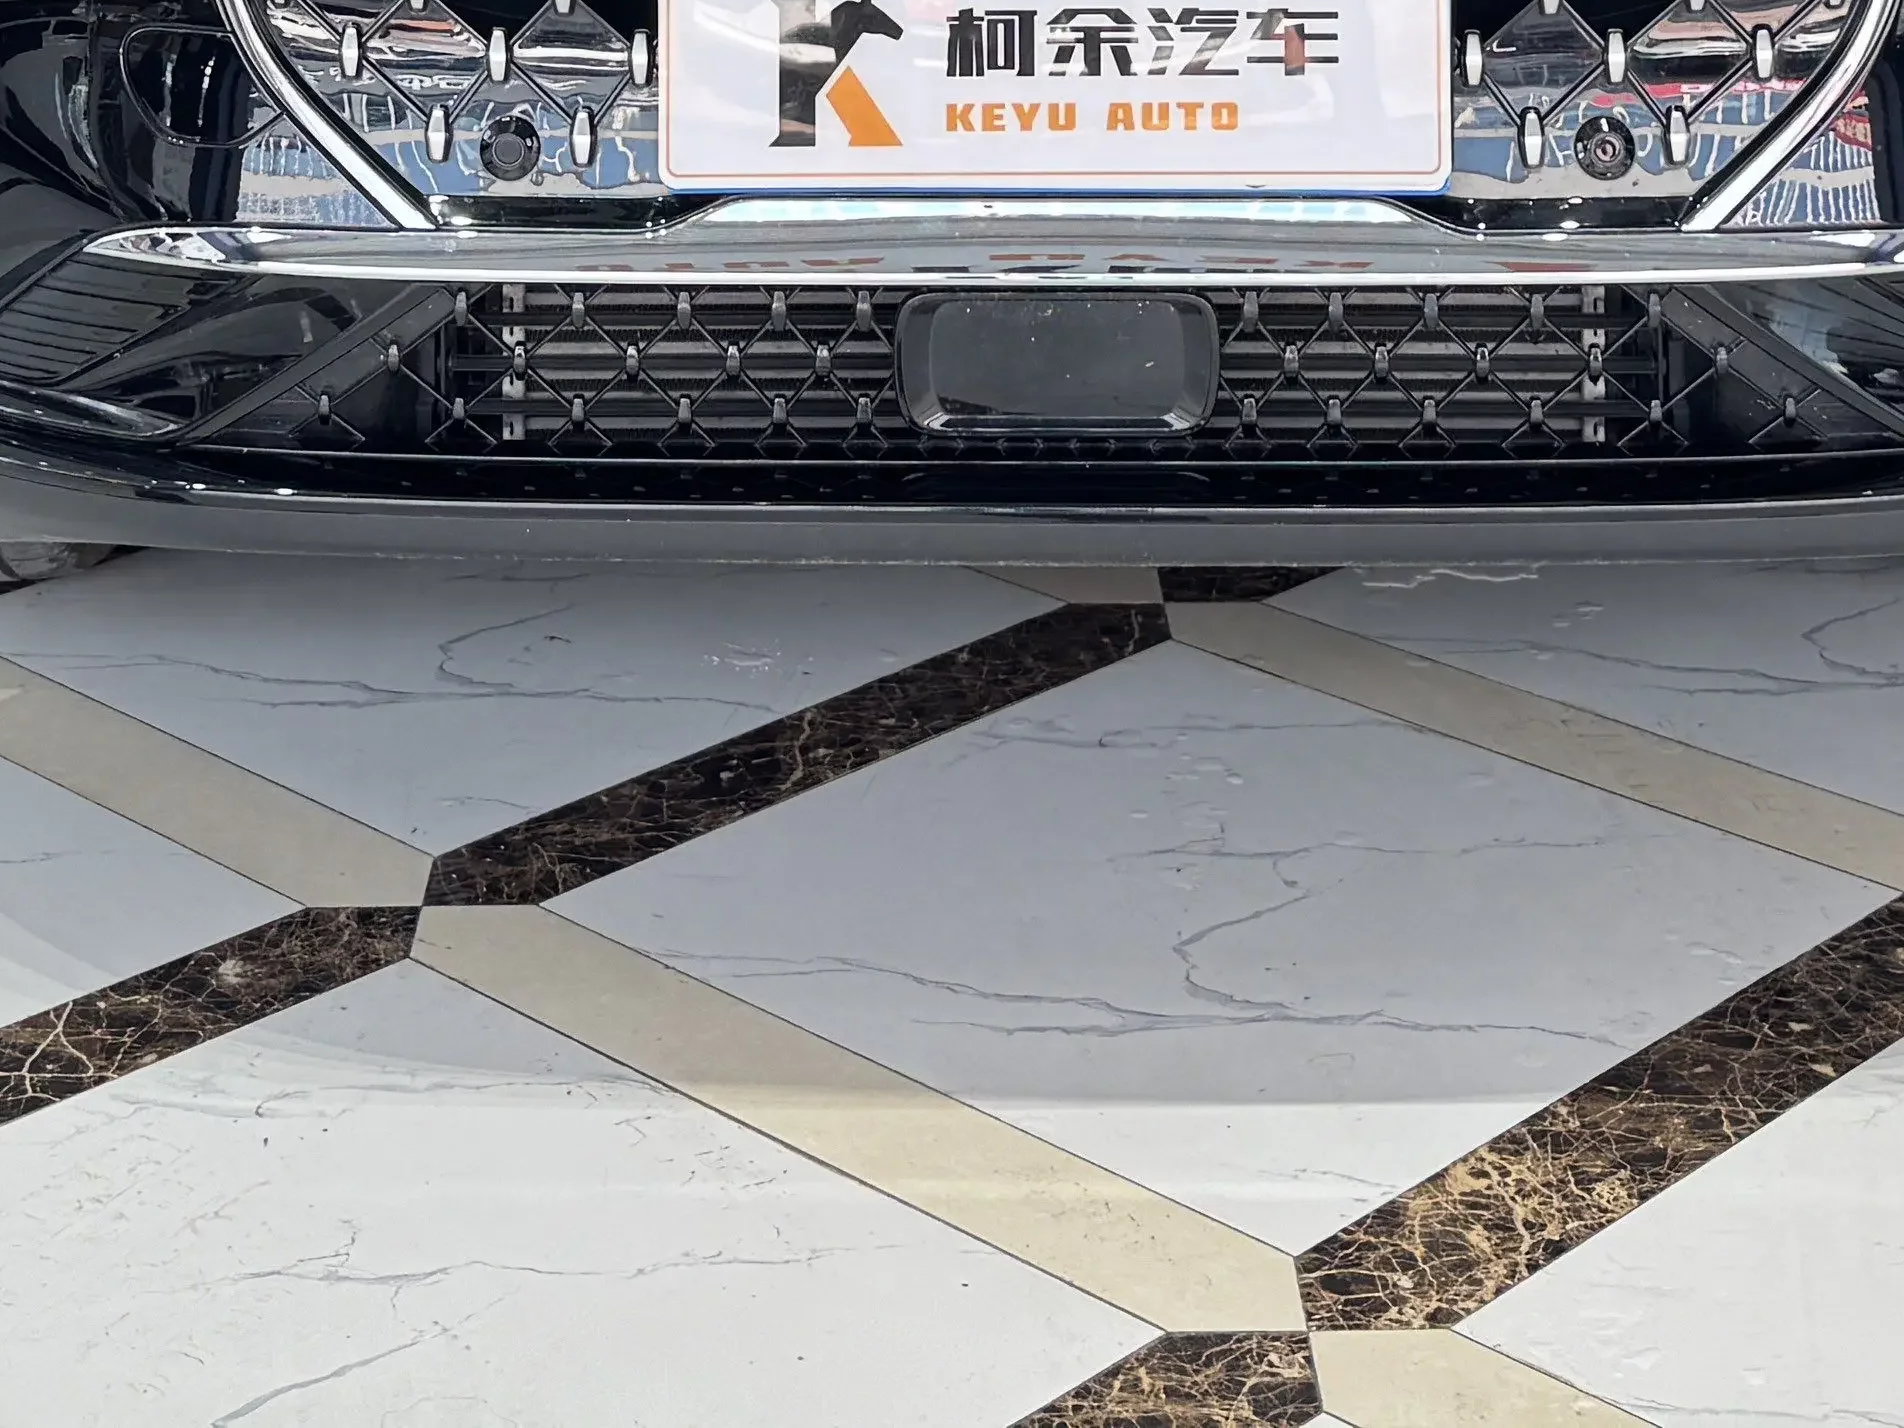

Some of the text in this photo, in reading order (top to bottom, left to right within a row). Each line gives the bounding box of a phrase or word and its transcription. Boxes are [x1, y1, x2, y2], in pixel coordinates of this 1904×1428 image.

[946, 7, 1340, 77] 柯余汽车
[946, 101, 1239, 132] KEYU AUTO
